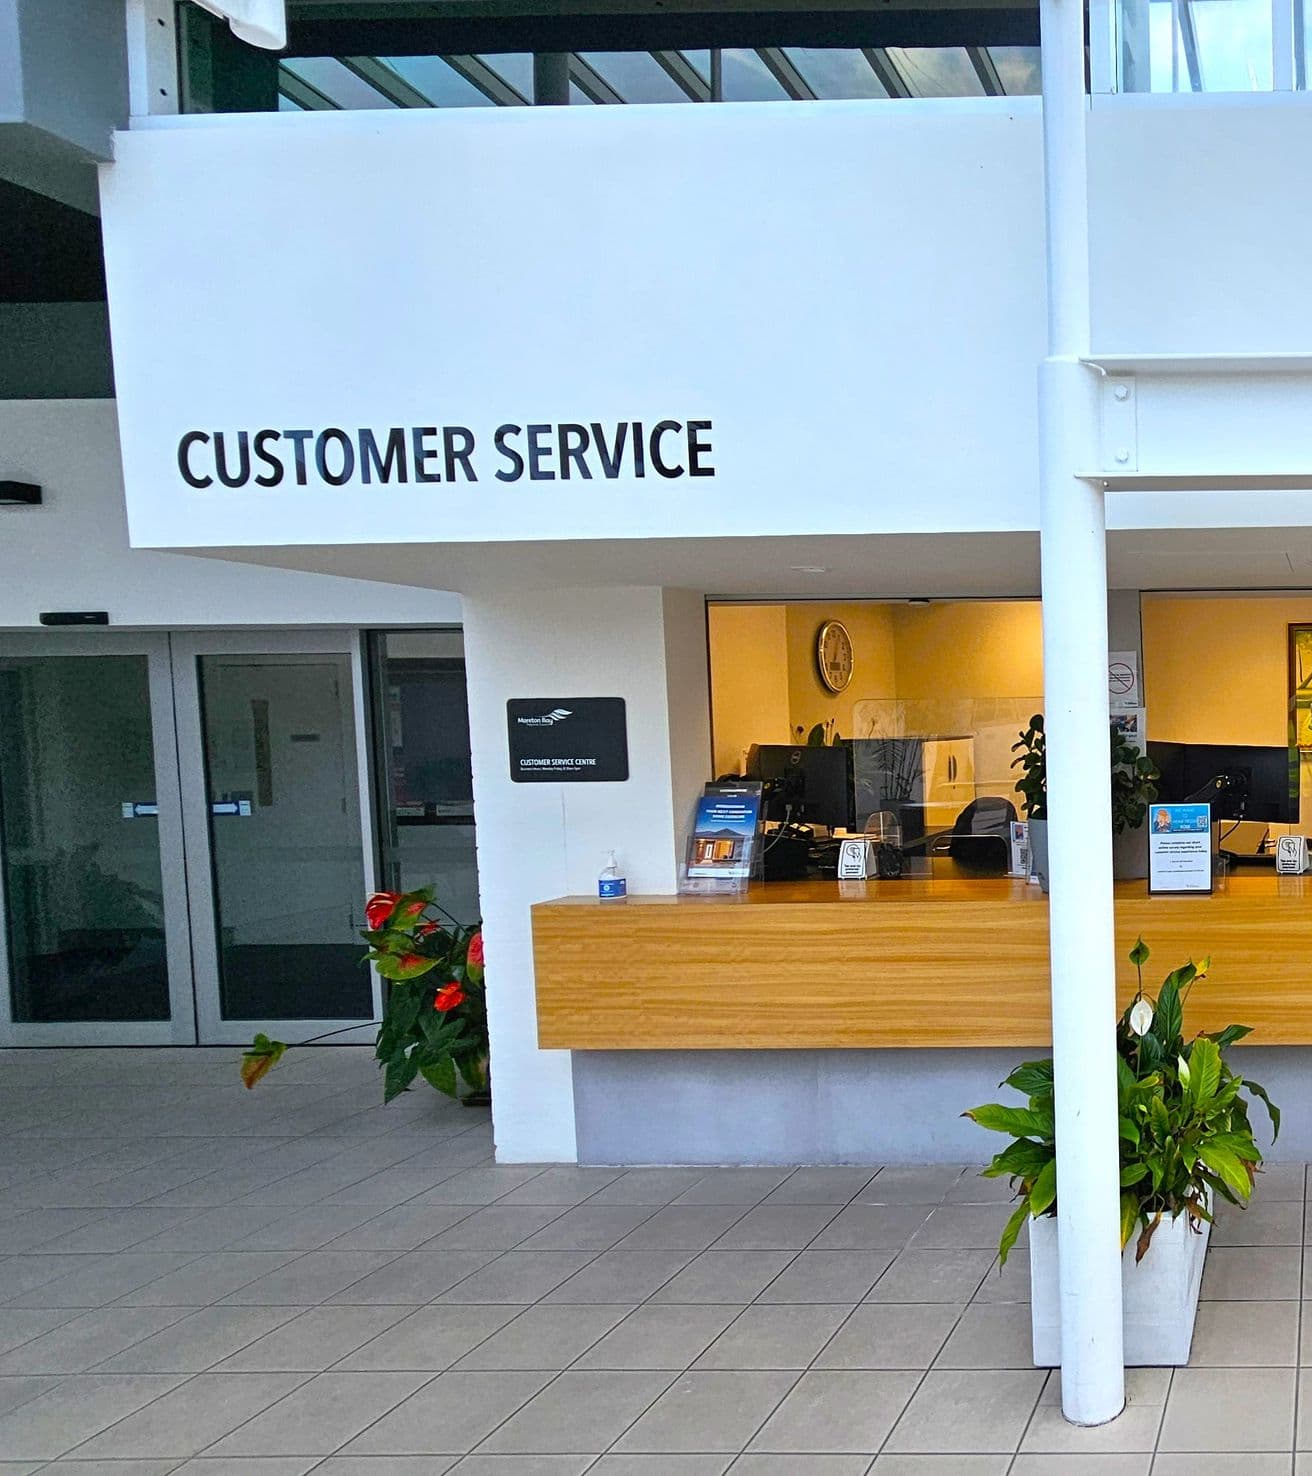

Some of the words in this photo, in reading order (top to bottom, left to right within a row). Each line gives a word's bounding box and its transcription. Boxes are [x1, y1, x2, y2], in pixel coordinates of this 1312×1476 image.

[177, 426, 479, 489] CUSTOMER
[494, 420, 716, 483] SERVICE
[542, 717, 554, 726] Bay
[520, 758, 551, 766] CUSTOMER
[551, 758, 574, 766] SERVICE
[575, 758, 597, 766] CENTRE
